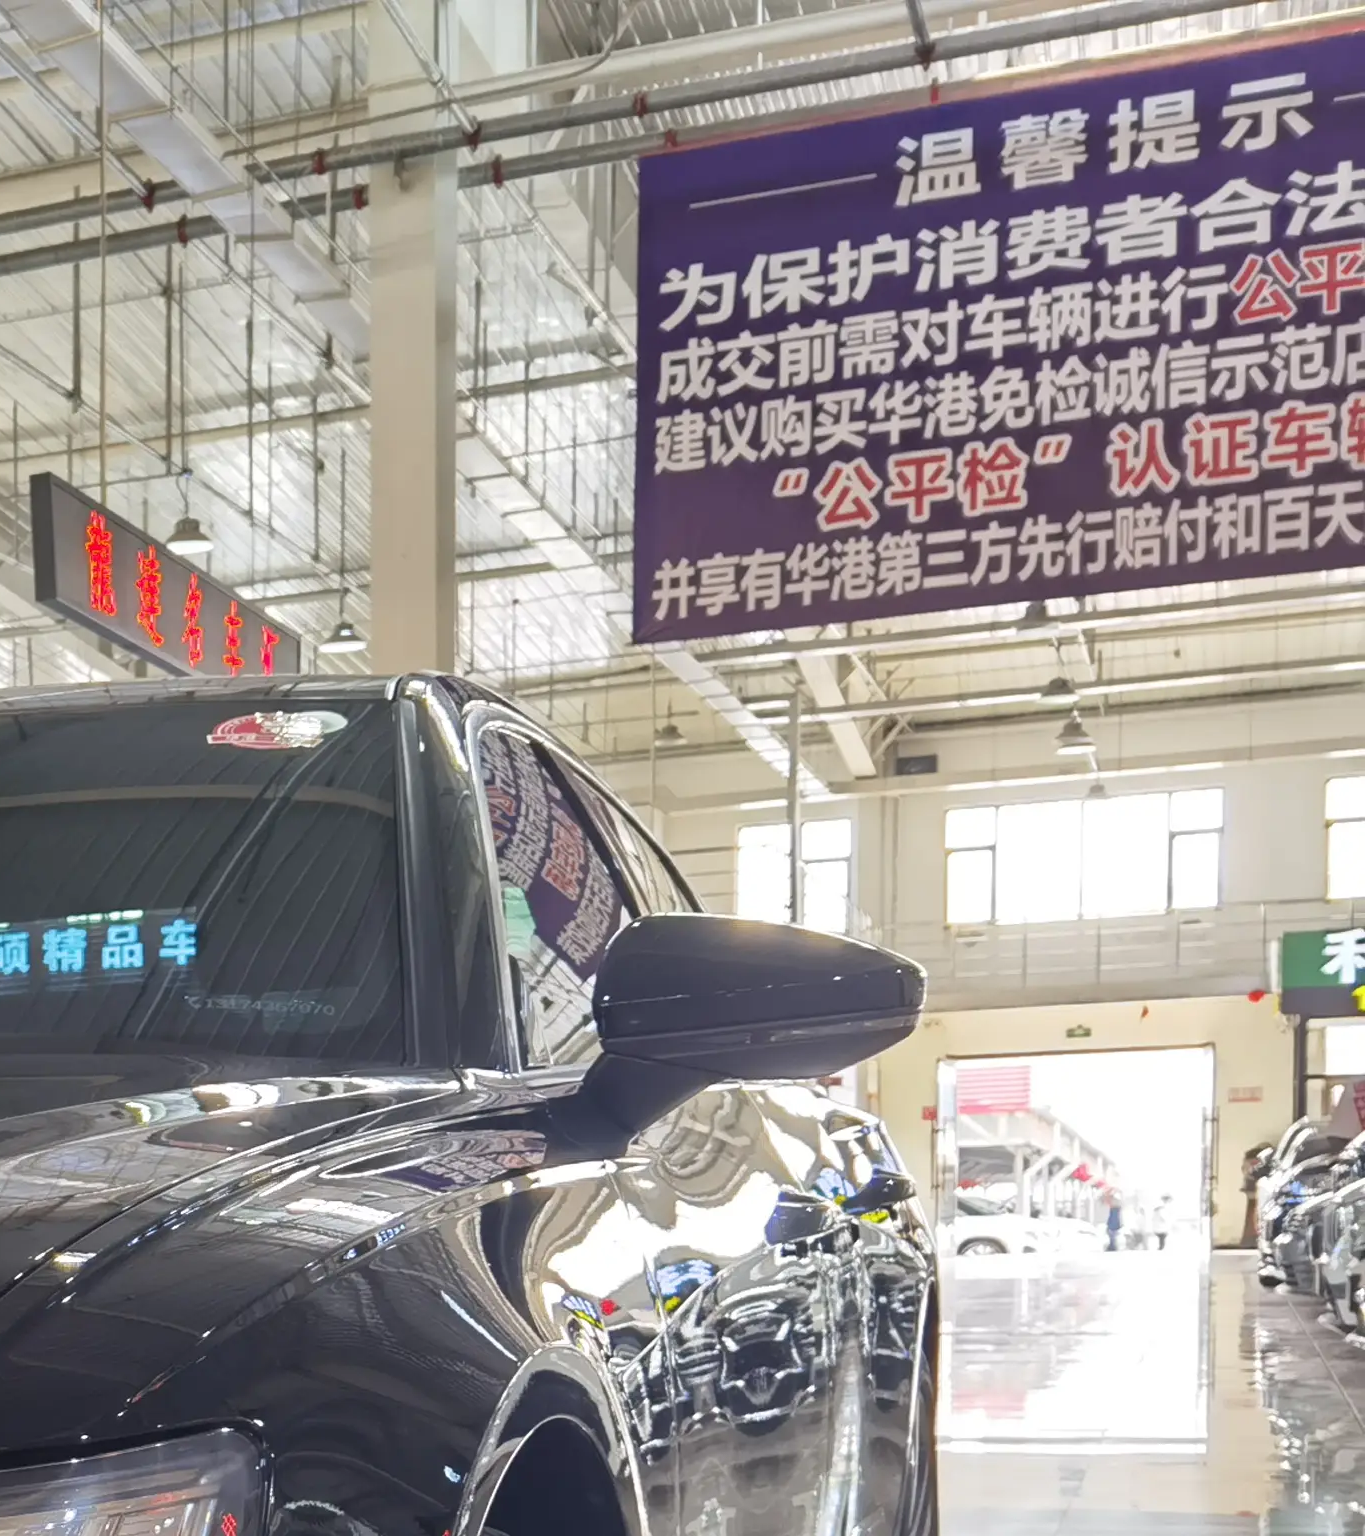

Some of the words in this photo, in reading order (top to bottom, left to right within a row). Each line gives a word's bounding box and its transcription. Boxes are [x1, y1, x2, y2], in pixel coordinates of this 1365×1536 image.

[894, 73, 1314, 207] 温馨提示
[656, 239, 1365, 402] 成交前需对车辆进行公平
[659, 159, 1365, 332] 为保护消费者合法
[653, 480, 1365, 621] 并享有华港第三方先行赔付和百天
